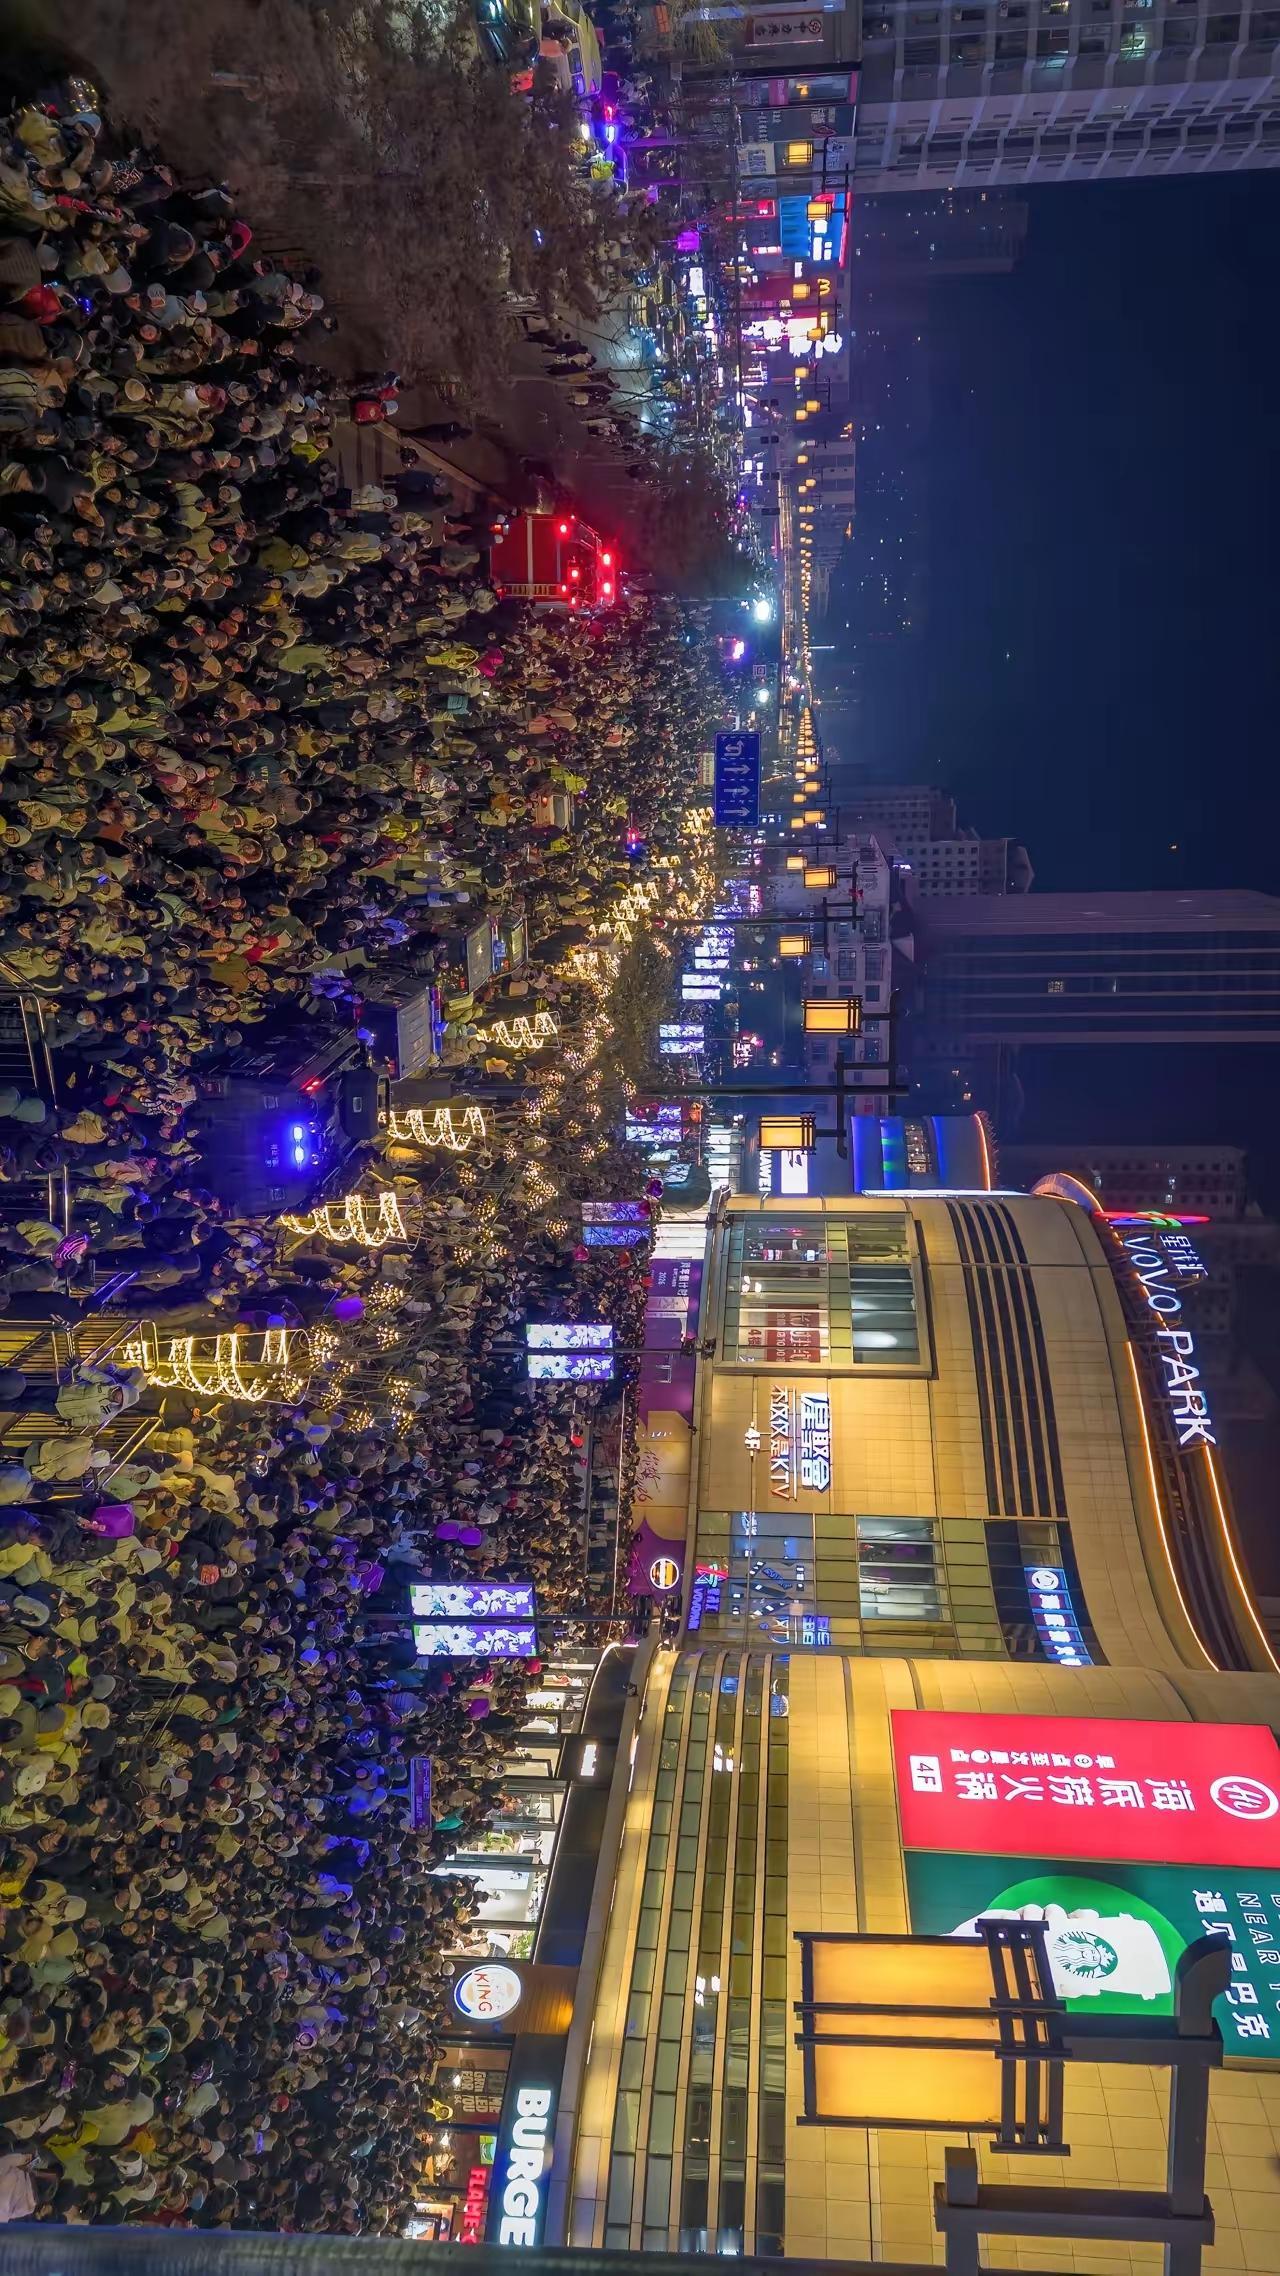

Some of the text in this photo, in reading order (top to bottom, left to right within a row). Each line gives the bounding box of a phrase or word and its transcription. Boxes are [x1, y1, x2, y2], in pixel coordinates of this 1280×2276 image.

[1160, 1235, 1208, 1277] 星茂汇
[1123, 1236, 1216, 1446] VOVO PARK
[769, 1385, 790, 1499] 不仅仅是KTV
[916, 1762, 936, 1785] 4F
[953, 1771, 1195, 1811] 海底捞火锅
[1236, 1892, 1280, 1964] NEAR
[474, 1973, 493, 2012] KING
[499, 2089, 551, 2246] BURGE
